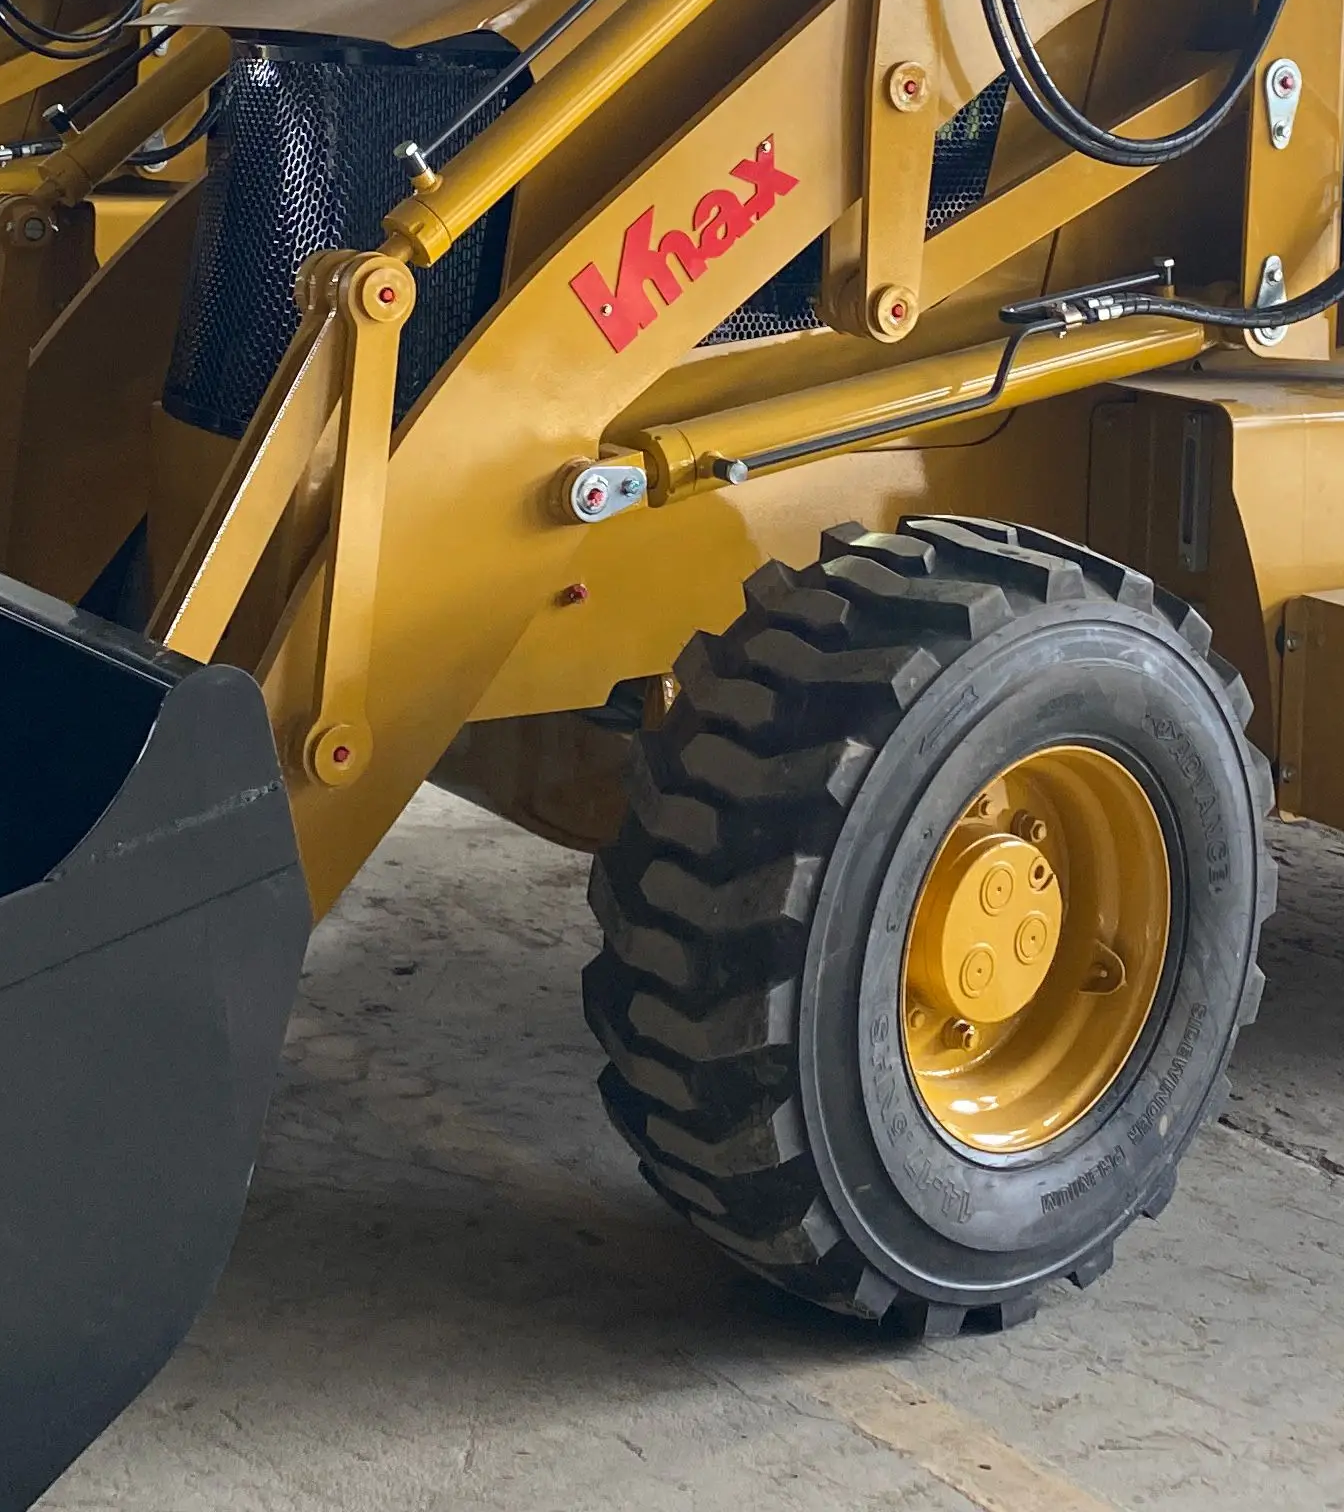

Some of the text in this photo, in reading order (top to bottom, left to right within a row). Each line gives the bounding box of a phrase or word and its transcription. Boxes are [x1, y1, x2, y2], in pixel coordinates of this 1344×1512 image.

[1169, 733, 1232, 883] ADVANCE
[1040, 1003, 1207, 1215] SIDEWINDER PREMIUM
